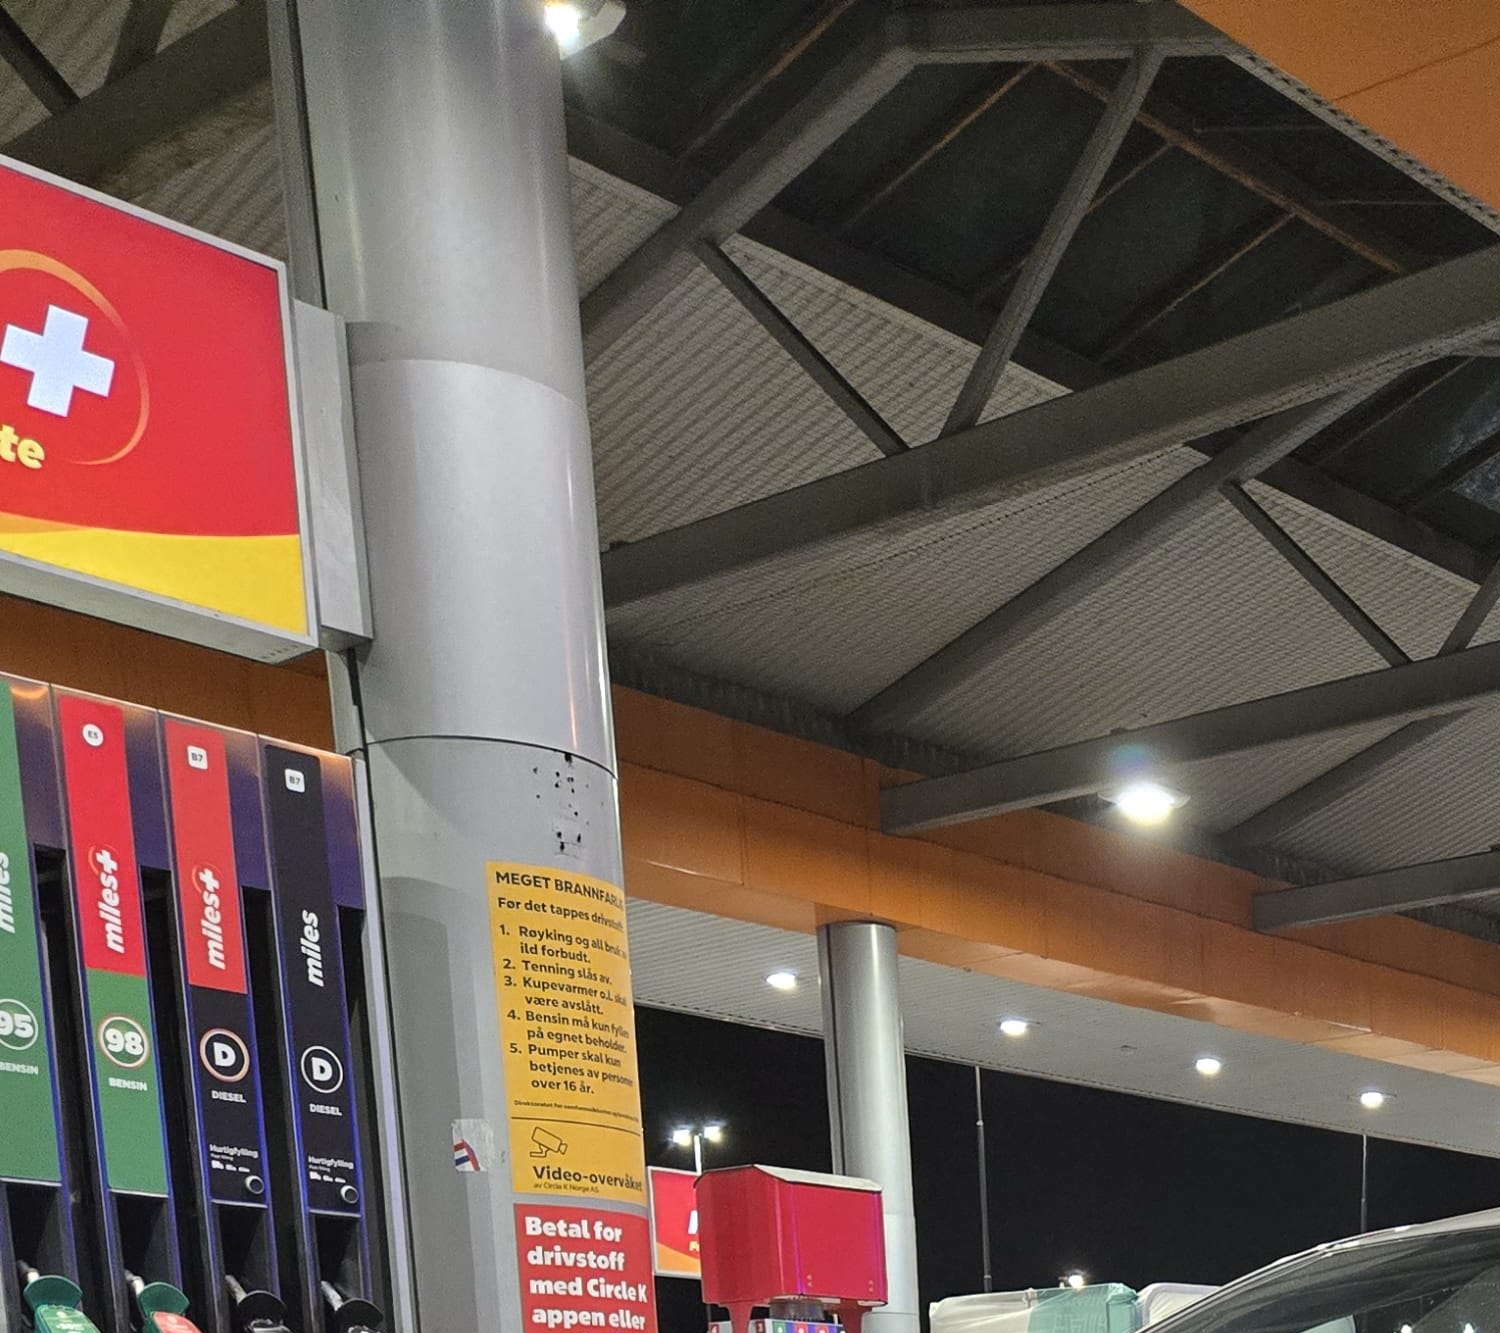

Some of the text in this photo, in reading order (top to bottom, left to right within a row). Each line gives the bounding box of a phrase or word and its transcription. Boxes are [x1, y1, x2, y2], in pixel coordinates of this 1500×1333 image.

[496, 871, 551, 889] MEGET
[498, 897, 521, 910] Før
[524, 900, 548, 913] det
[550, 904, 590, 920] tappes
[300, 909, 325, 988] miles
[499, 924, 510, 936] 1.
[519, 925, 573, 945] Røyking
[575, 936, 589, 949] og
[591, 939, 603, 951] all
[520, 942, 591, 963] ild forbudt.
[503, 958, 612, 985] 2. Tenning slås av.
[504, 975, 517, 986] 3.
[522, 976, 598, 997] Kupevarmer
[525, 995, 604, 1015] være avslått.
[0, 1010, 34, 1037] 95
[507, 1009, 521, 1021] 4.
[525, 1010, 570, 1026] Bensin
[572, 1016, 590, 1029] må
[592, 1018, 610, 1033] kun
[104, 1028, 145, 1056] 98
[527, 1026, 544, 1041] på
[547, 1031, 584, 1044] egnet
[213, 1042, 236, 1067] D
[509, 1042, 621, 1068] 5. Pumper skal kun
[0, 1061, 39, 1076] BENSIN
[311, 1057, 333, 1081] D
[529, 1060, 585, 1077] betjenes
[587, 1069, 599, 1079] av
[108, 1077, 148, 1092] BENSIN
[531, 1079, 594, 1095] over 16 år.
[211, 1090, 247, 1104] DIESEL
[309, 1103, 343, 1117] DIESEL
[532, 1165, 643, 1192] Video-overvåket
[525, 1216, 623, 1243] Betal for
[527, 1245, 625, 1271] drivstoff
[529, 1276, 648, 1303] med Circle K
[532, 1307, 646, 1331] appen eller
